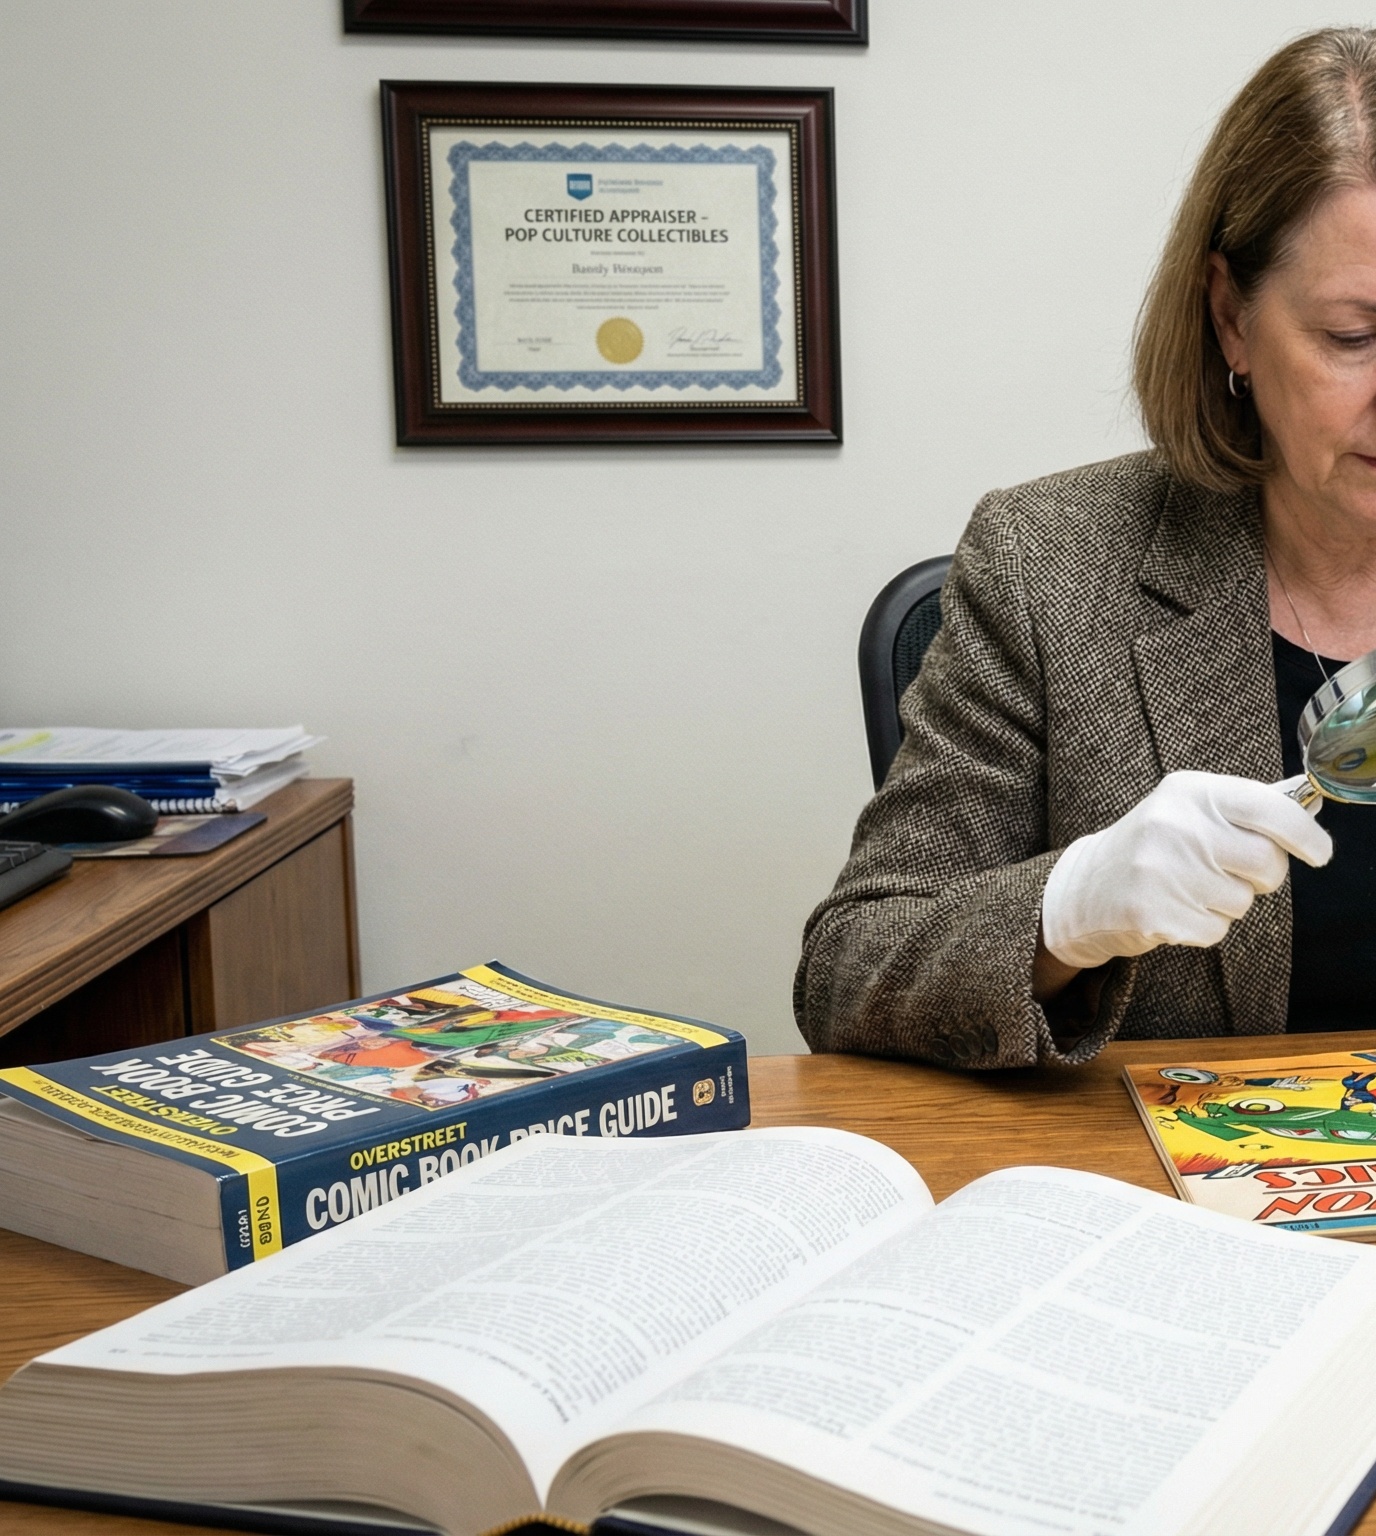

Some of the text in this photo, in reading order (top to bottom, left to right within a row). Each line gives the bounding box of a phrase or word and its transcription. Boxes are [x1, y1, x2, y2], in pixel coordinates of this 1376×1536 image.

[505, 228, 729, 243] POP CULTURE COLLECTIBLES
[524, 209, 605, 223] CERTIFIED
[609, 209, 697, 224] APPRAISER
[89, 1058, 329, 1138] COMIC BOOK
[155, 1049, 382, 1121] PRICE GUIDE
[305, 1163, 411, 1230] COMIC
[599, 1084, 678, 1138] GUIDE
[350, 1122, 467, 1171] OVERSTREET
